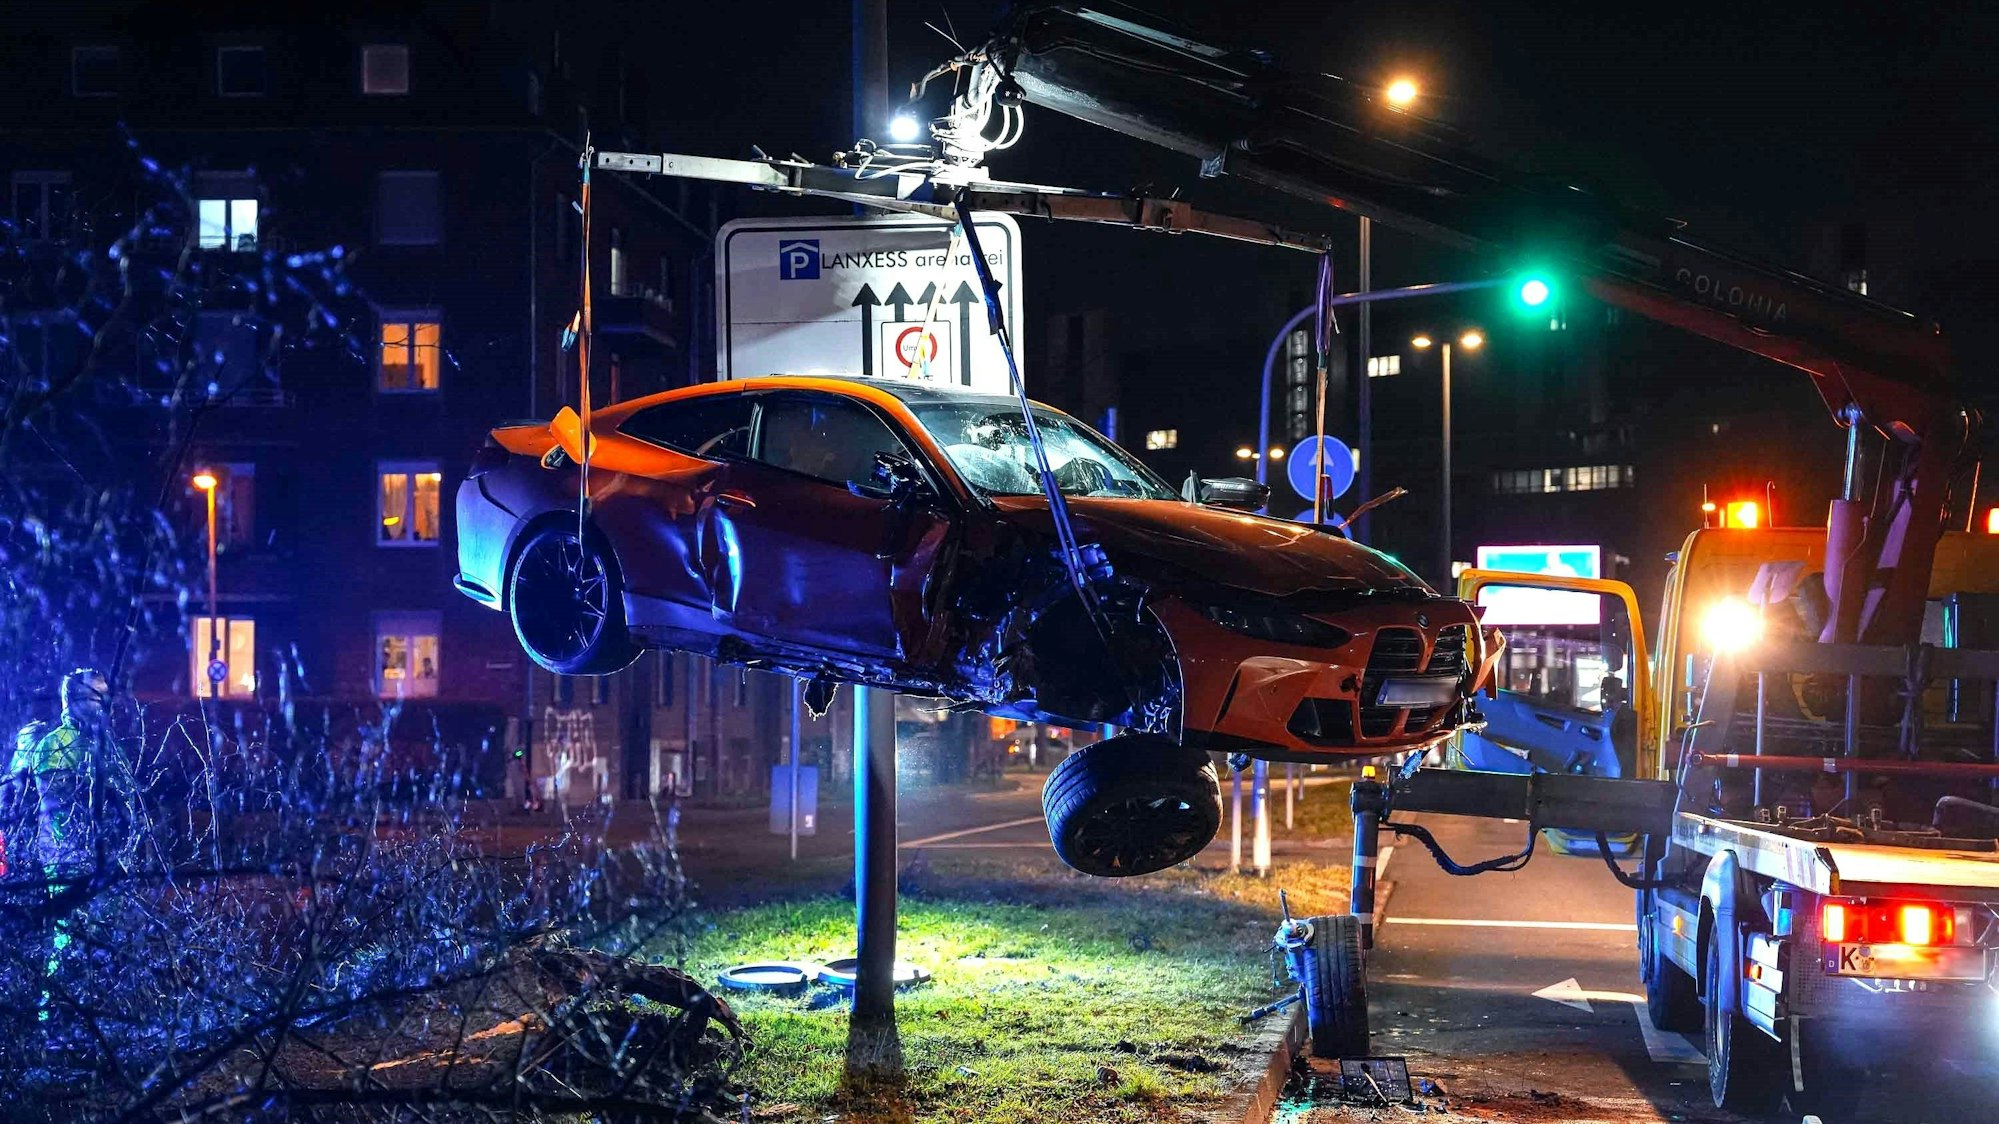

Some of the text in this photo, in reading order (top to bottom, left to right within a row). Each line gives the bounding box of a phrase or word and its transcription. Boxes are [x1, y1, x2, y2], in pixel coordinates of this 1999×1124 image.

[790, 252, 809, 278] P
[821, 251, 908, 269] LANXESS
[1676, 267, 1787, 321] COLONIA
[1828, 959, 1835, 968] D
[1841, 946, 1857, 971] K
